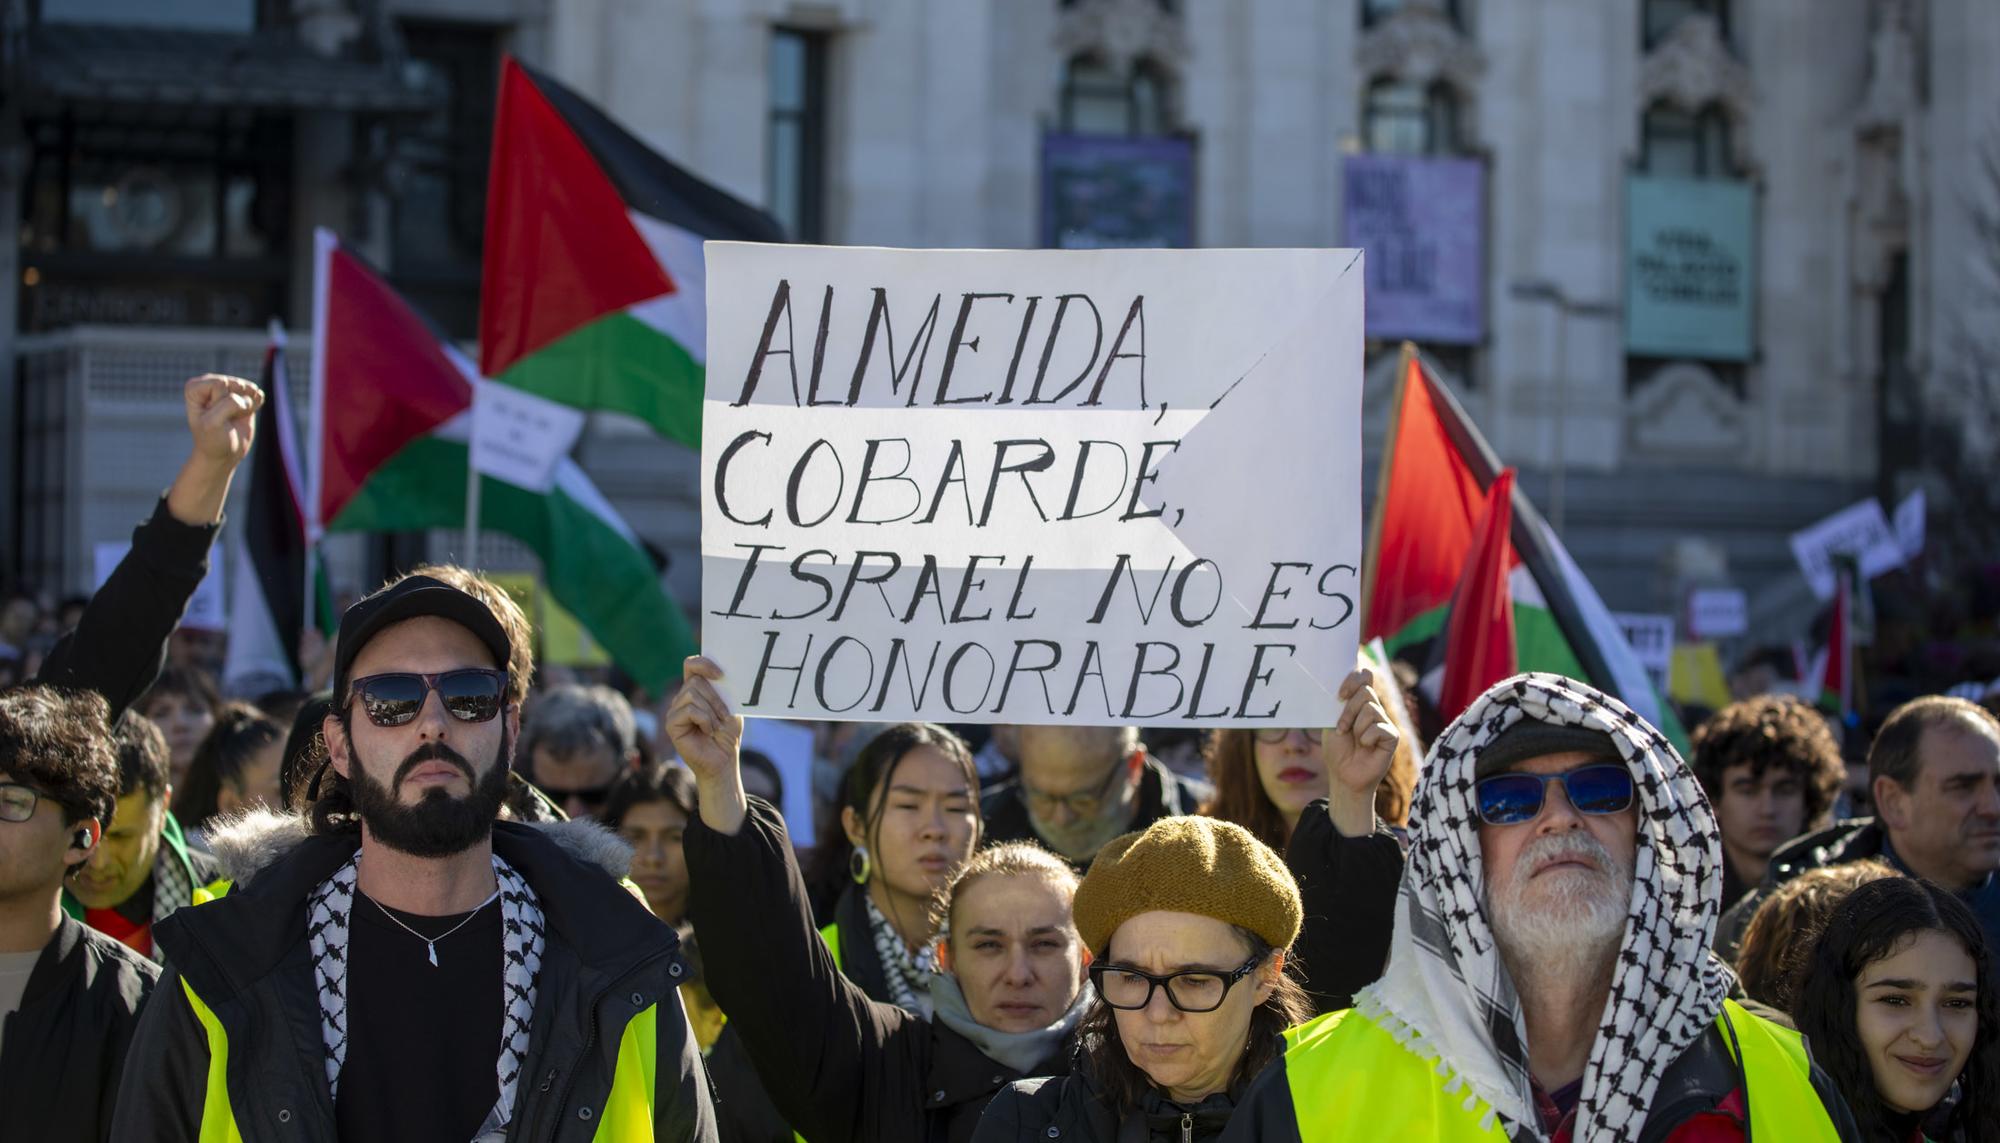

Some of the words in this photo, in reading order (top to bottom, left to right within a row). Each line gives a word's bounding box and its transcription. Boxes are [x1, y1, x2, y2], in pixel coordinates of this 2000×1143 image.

[729, 279, 1168, 426] ALMEIDA,
[713, 429, 1185, 529] COBARDE,
[710, 542, 1037, 626] ISRAEL
[1086, 553, 1224, 629] NO
[1241, 562, 1357, 631] ES
[741, 631, 1297, 719] HONORABLE
